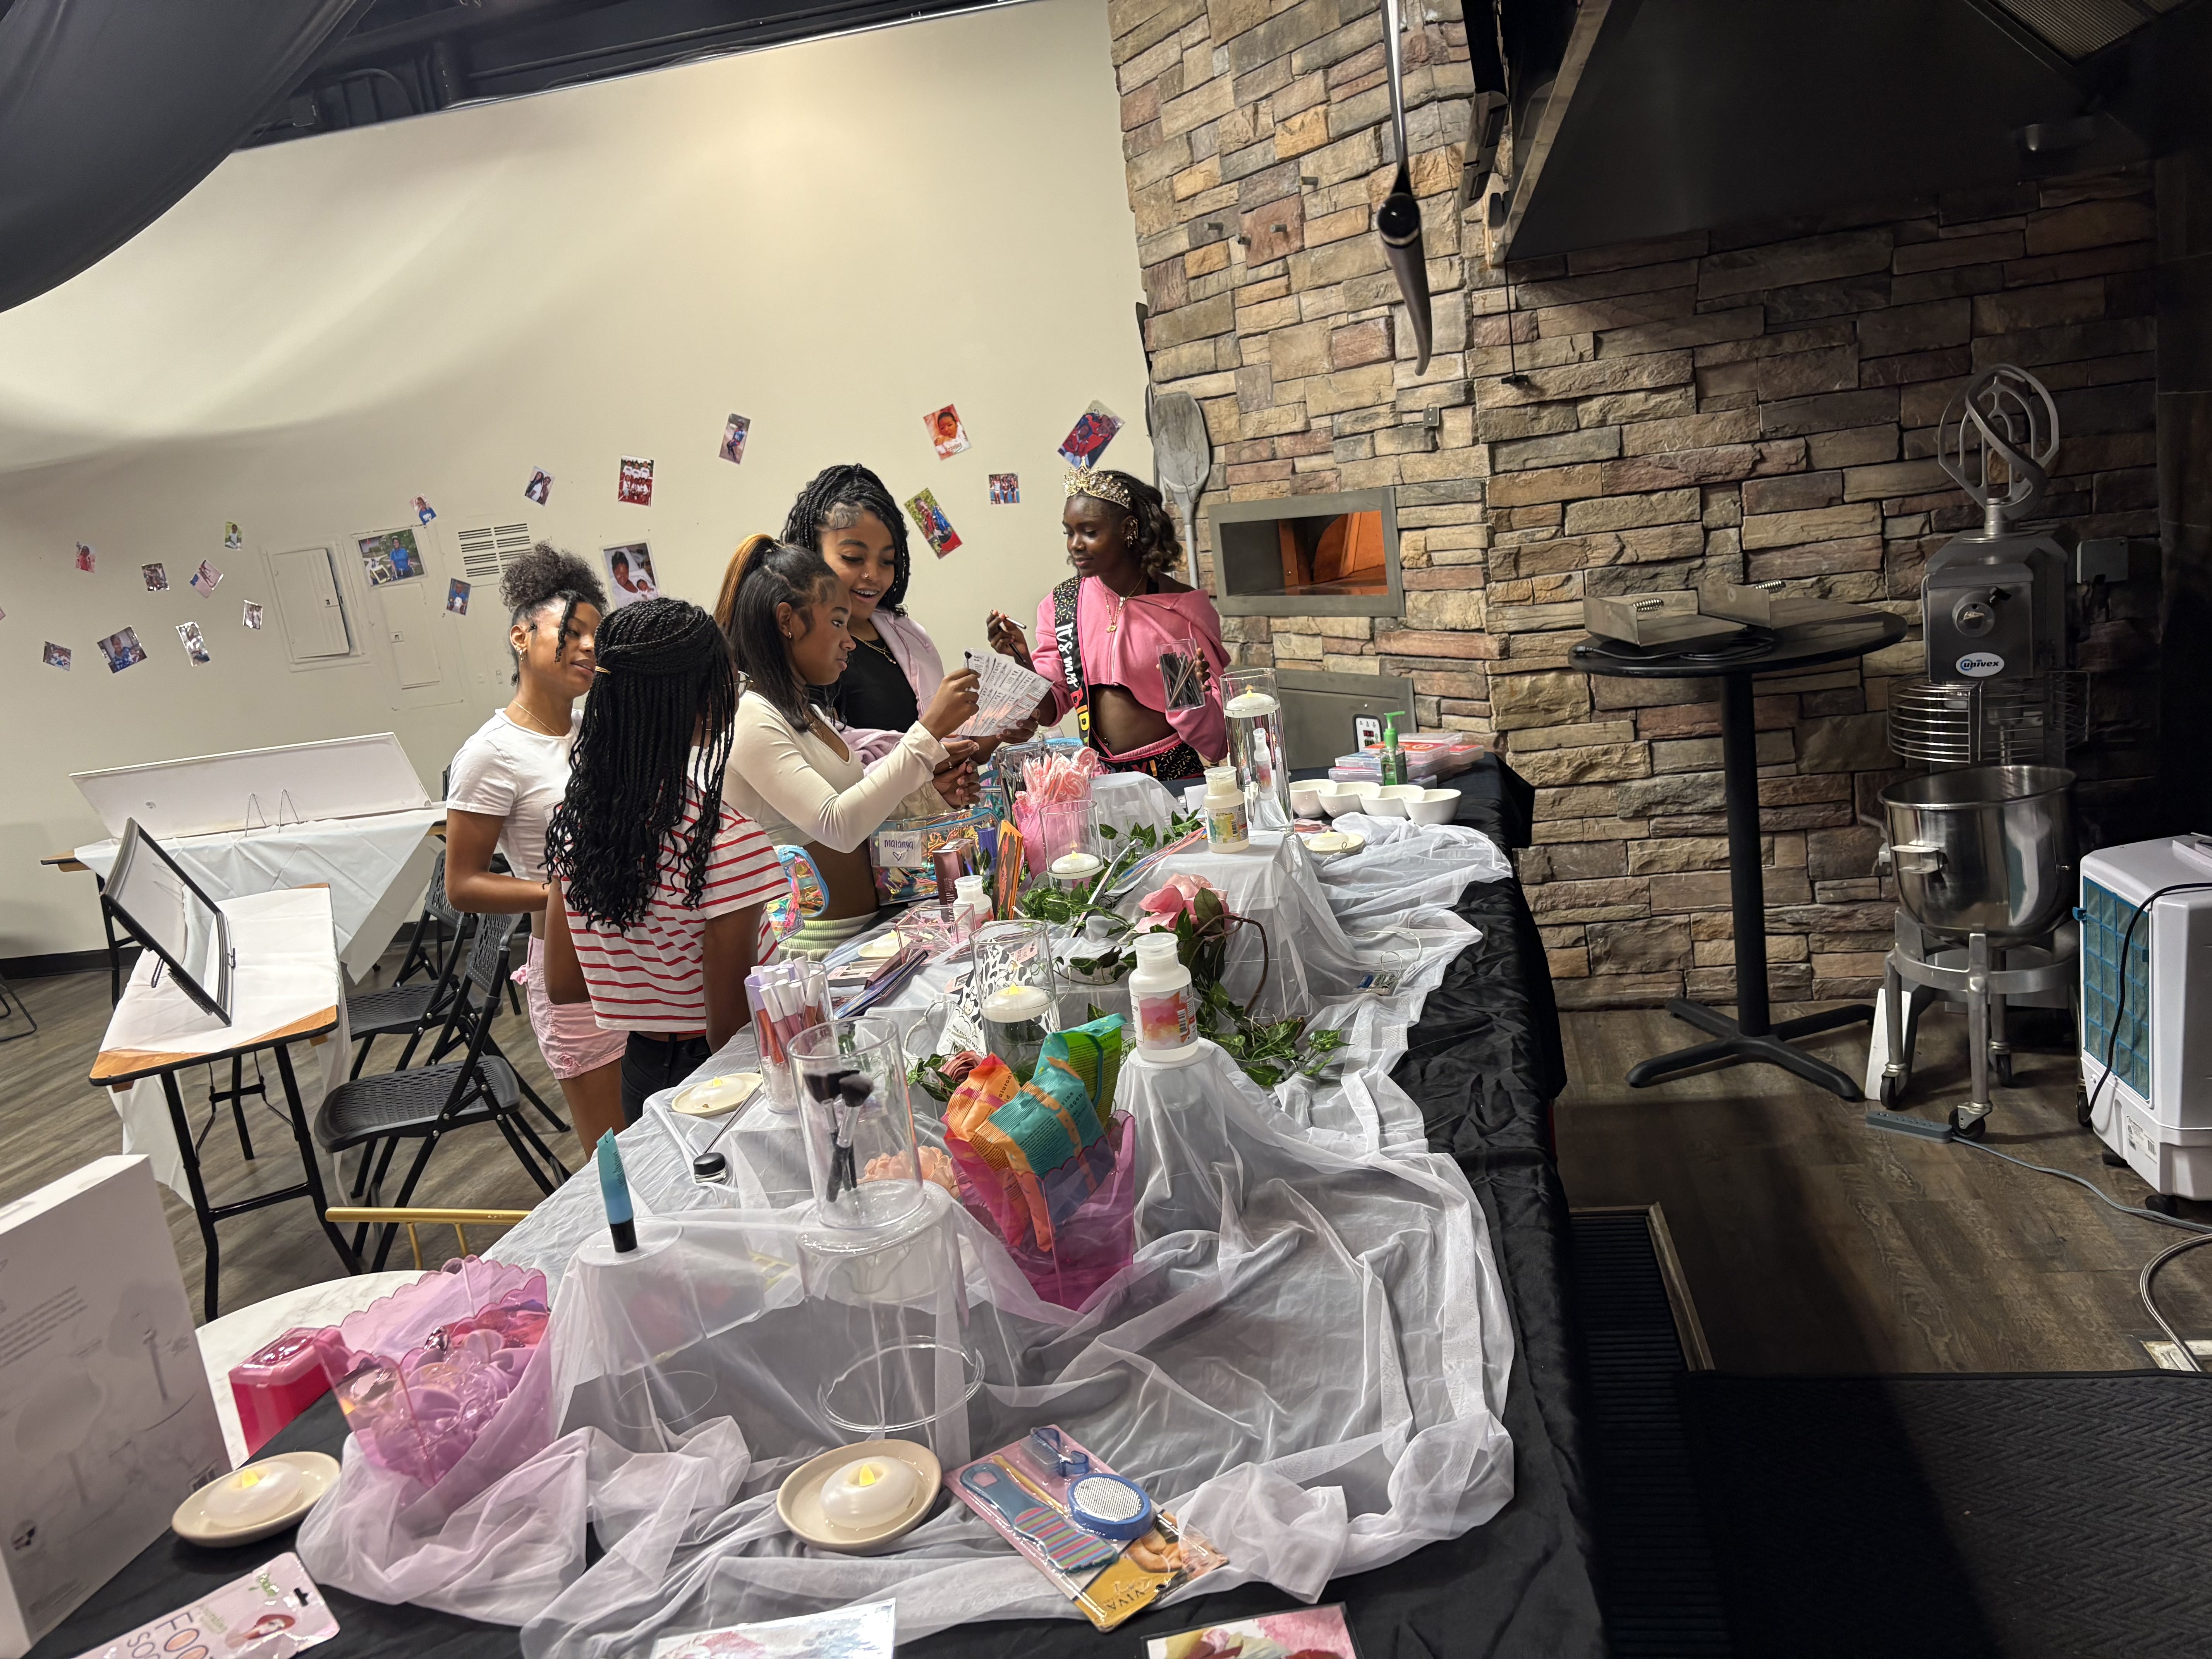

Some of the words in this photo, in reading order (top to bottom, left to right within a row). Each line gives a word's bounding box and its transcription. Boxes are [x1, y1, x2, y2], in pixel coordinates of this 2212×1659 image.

[1055, 622, 1073, 654] It's
[1063, 657, 1079, 688] my
[1961, 659, 1999, 670] univex
[127, 1632, 161, 1659] SO
[155, 1611, 212, 1659] FOO
